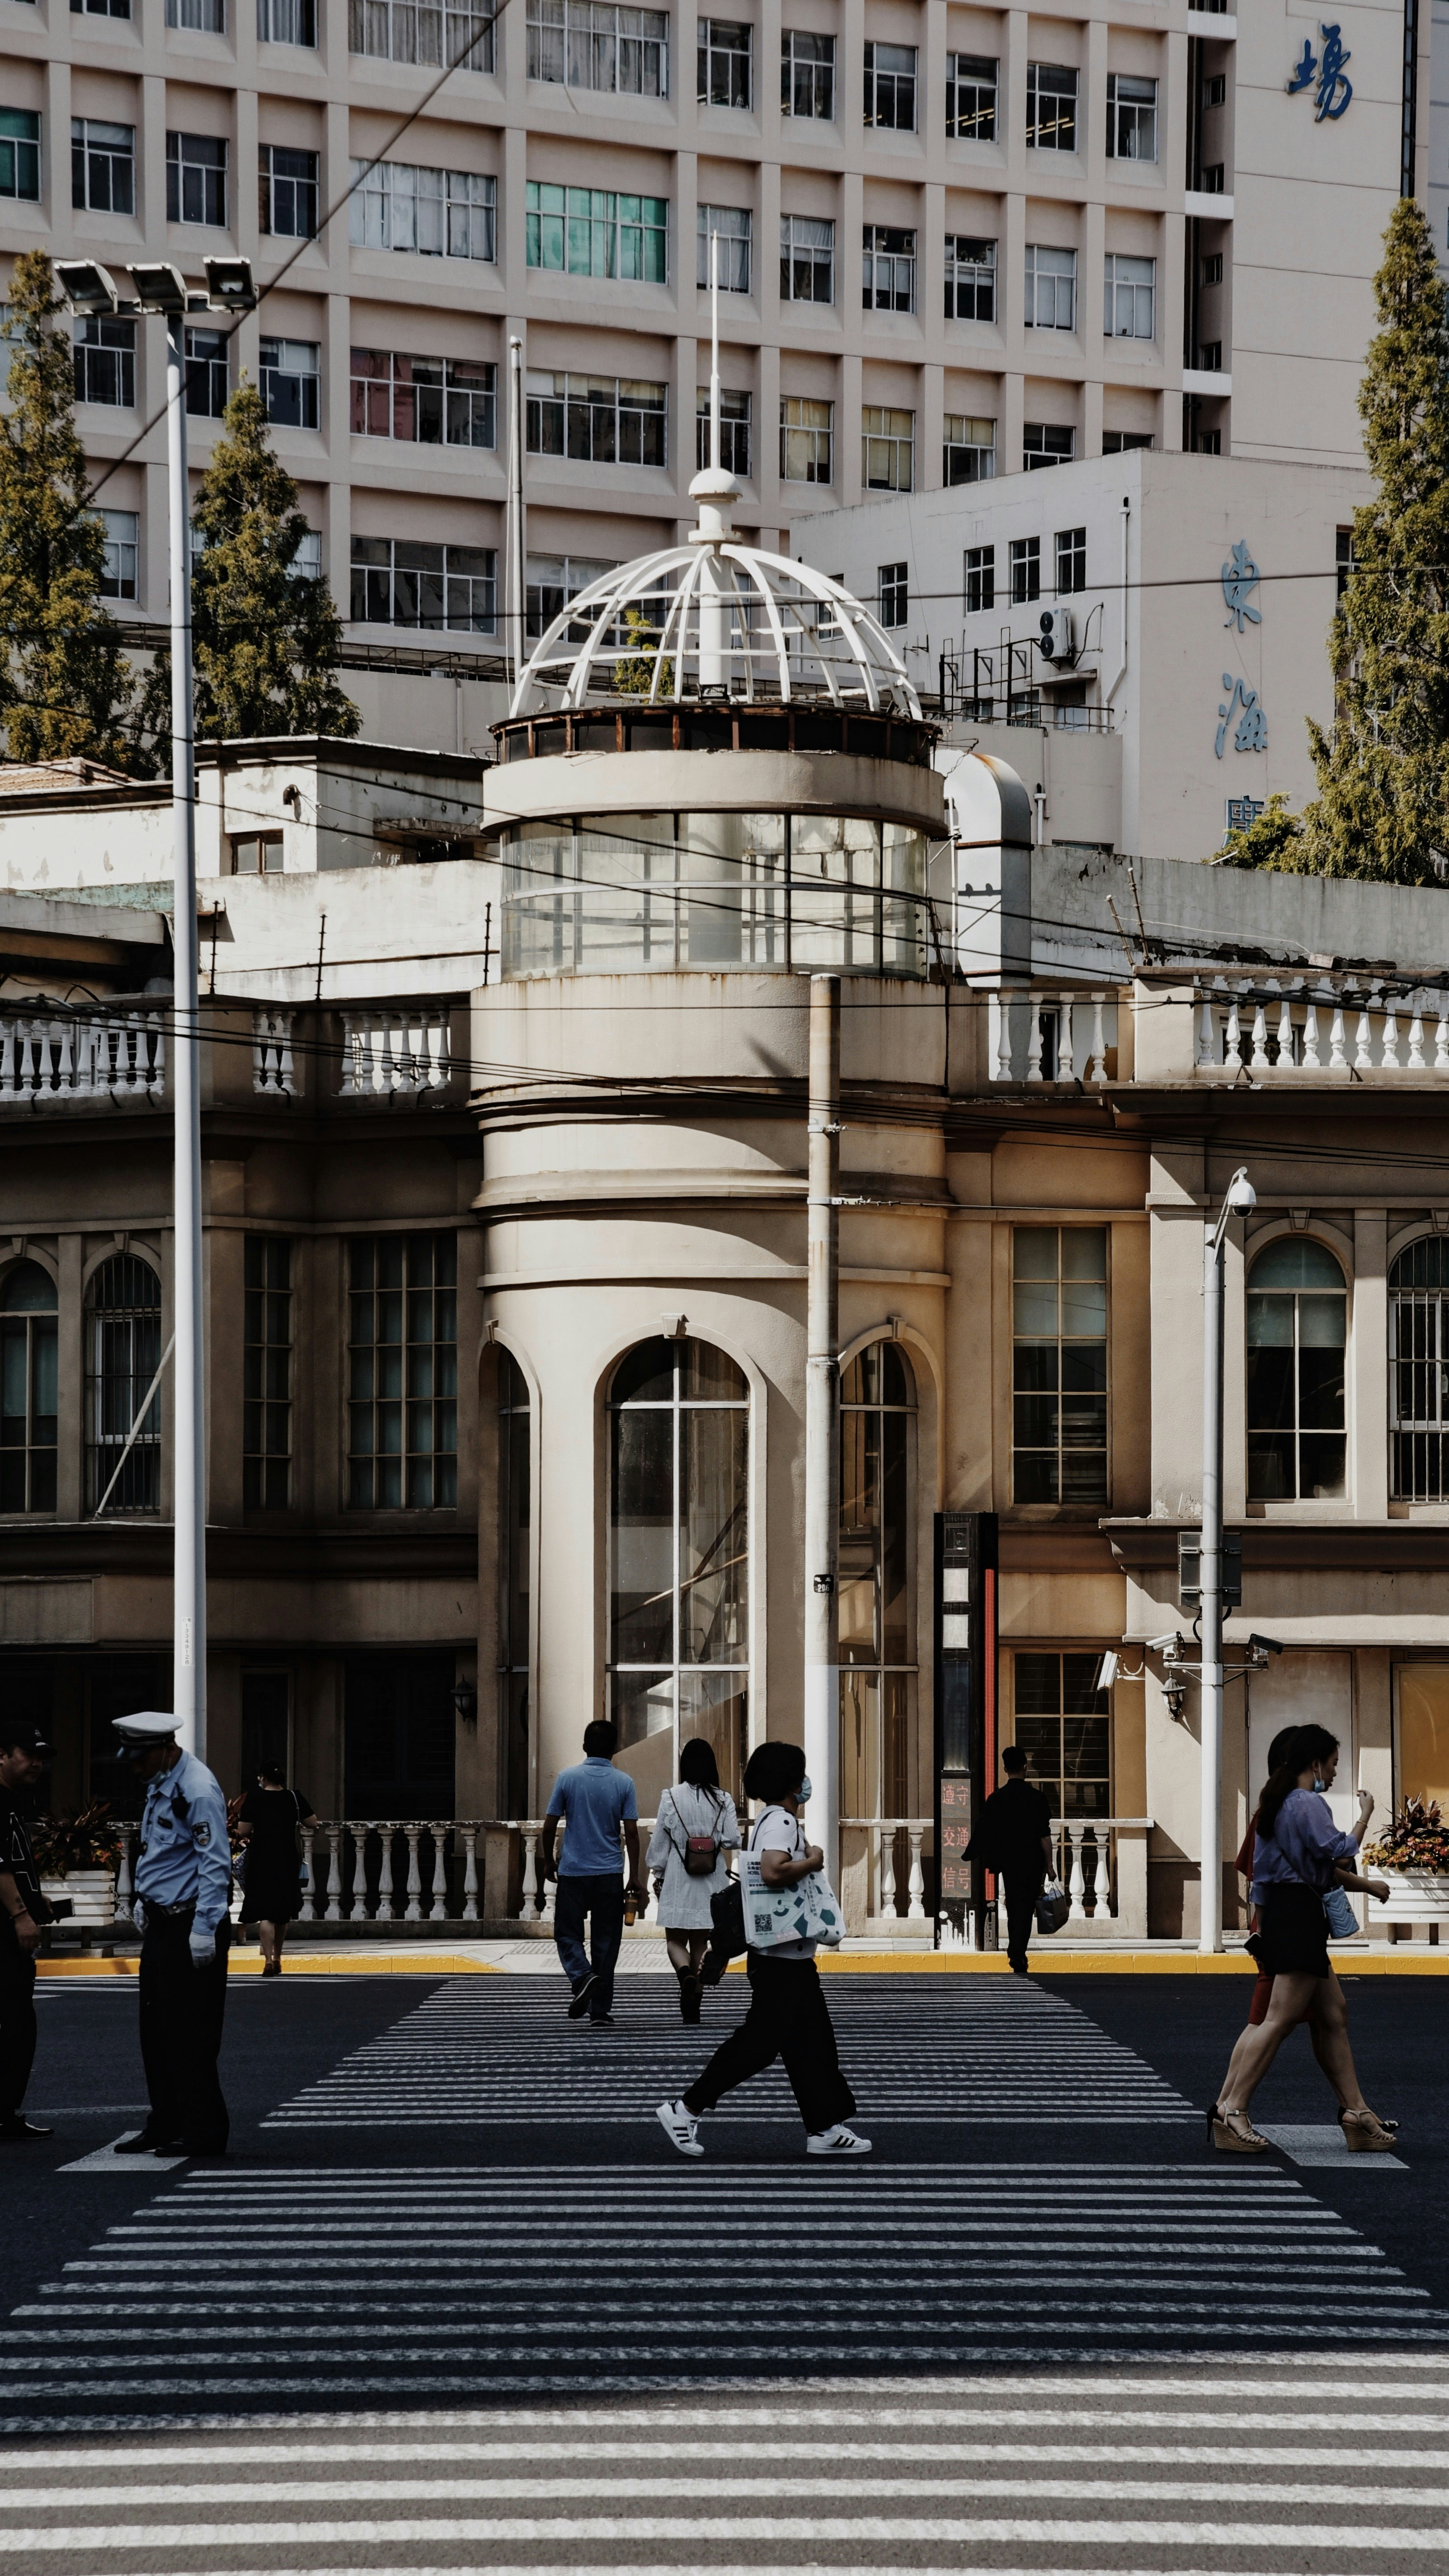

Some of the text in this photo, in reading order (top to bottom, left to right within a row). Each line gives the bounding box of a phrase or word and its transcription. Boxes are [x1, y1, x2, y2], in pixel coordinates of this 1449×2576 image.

[1286, 24, 1353, 122] 場
[942, 1785, 969, 1806] 遵守
[943, 1826, 969, 1847] 交通
[943, 1866, 971, 1890] 信号
